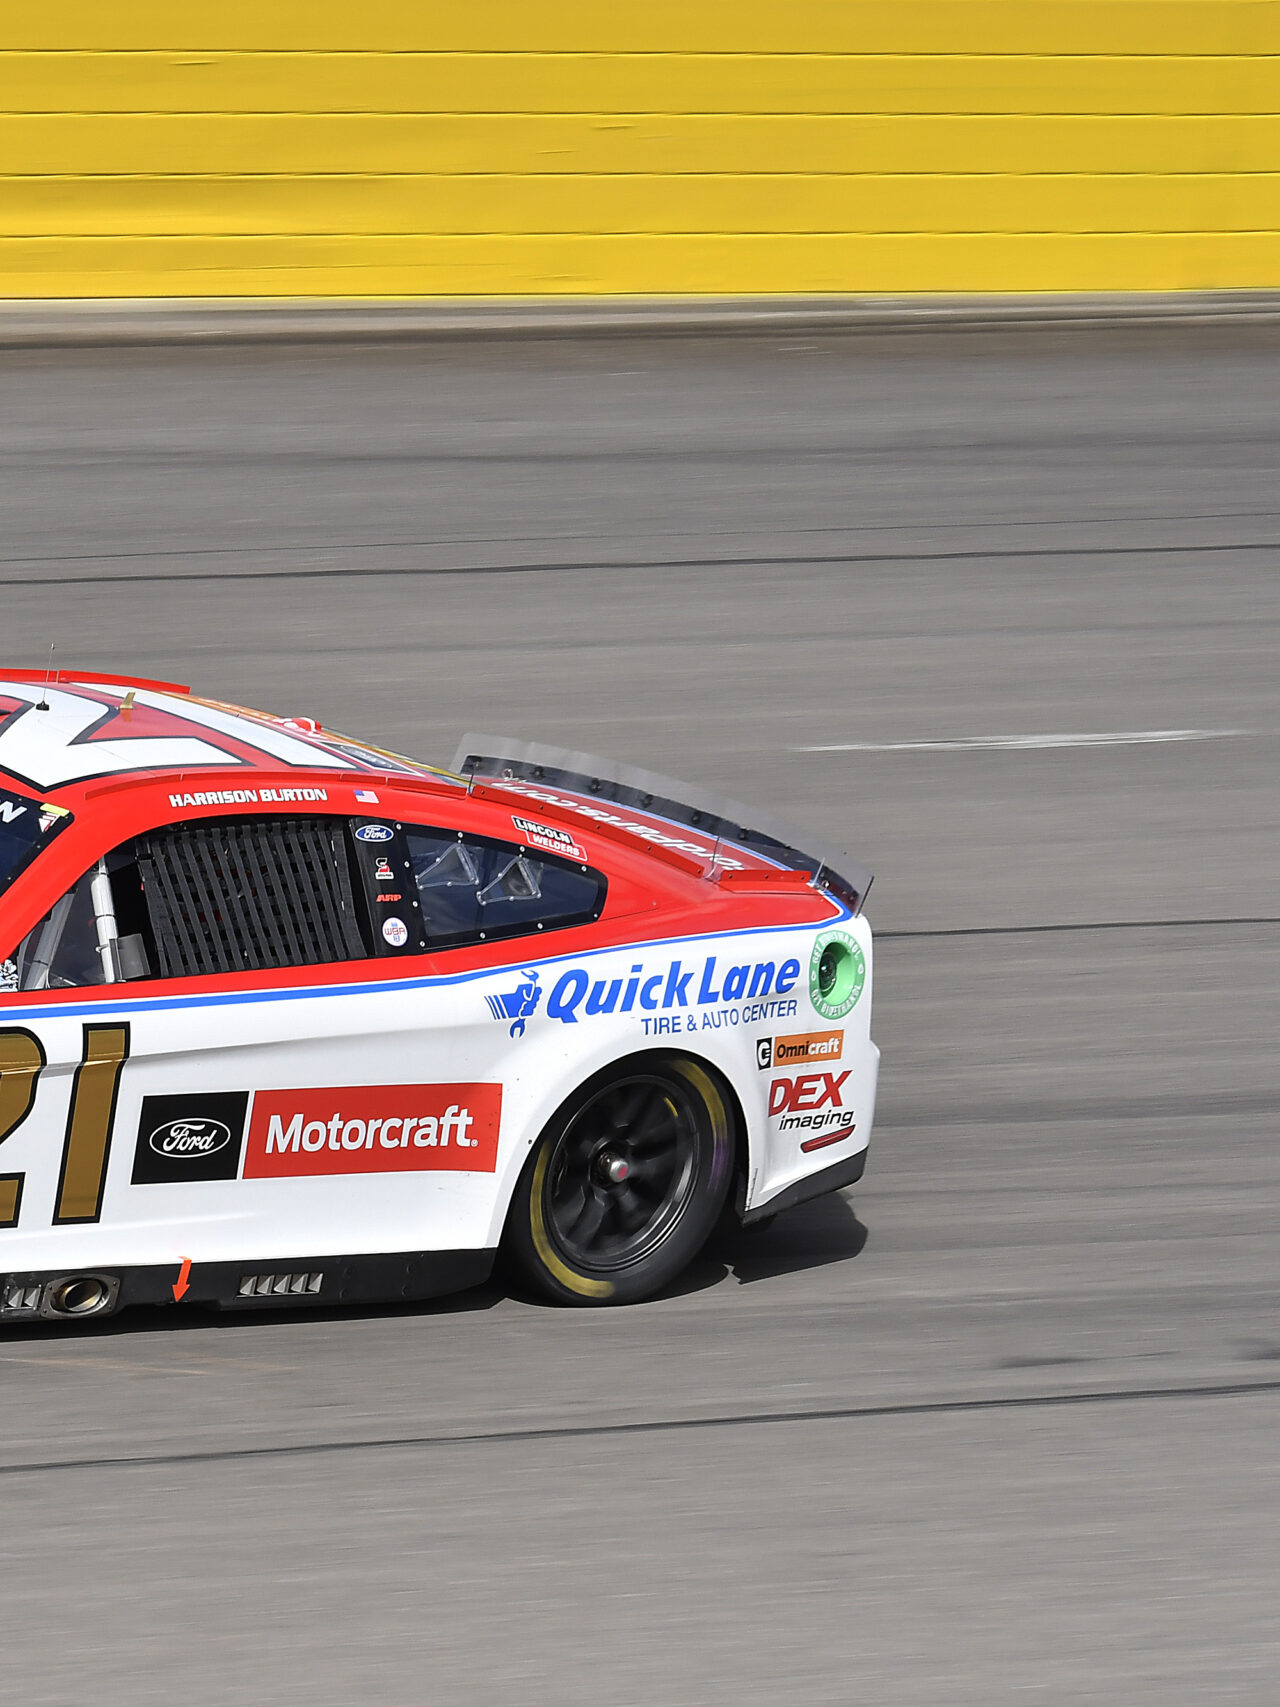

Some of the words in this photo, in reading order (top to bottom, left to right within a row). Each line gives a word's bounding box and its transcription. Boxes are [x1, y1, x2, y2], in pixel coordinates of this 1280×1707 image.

[168, 789, 258, 807] HARRISON
[259, 788, 328, 802] BURTON
[363, 827, 388, 839] Ford
[515, 819, 571, 844] LINCOLN
[532, 834, 580, 856] WELDERS
[375, 893, 402, 902] ARP
[546, 960, 695, 1023] Quick
[696, 956, 801, 1005] Lane
[640, 1015, 682, 1036] TIRE
[686, 1014, 698, 1032] &
[701, 1008, 740, 1031] AUTO
[742, 1000, 798, 1023] CENTER
[776, 1037, 840, 1059] Omnicraft
[768, 1070, 854, 1118] DEX
[265, 1104, 475, 1154] Motorcraft
[779, 1109, 855, 1131] imaging
[162, 1122, 216, 1152] Ford
